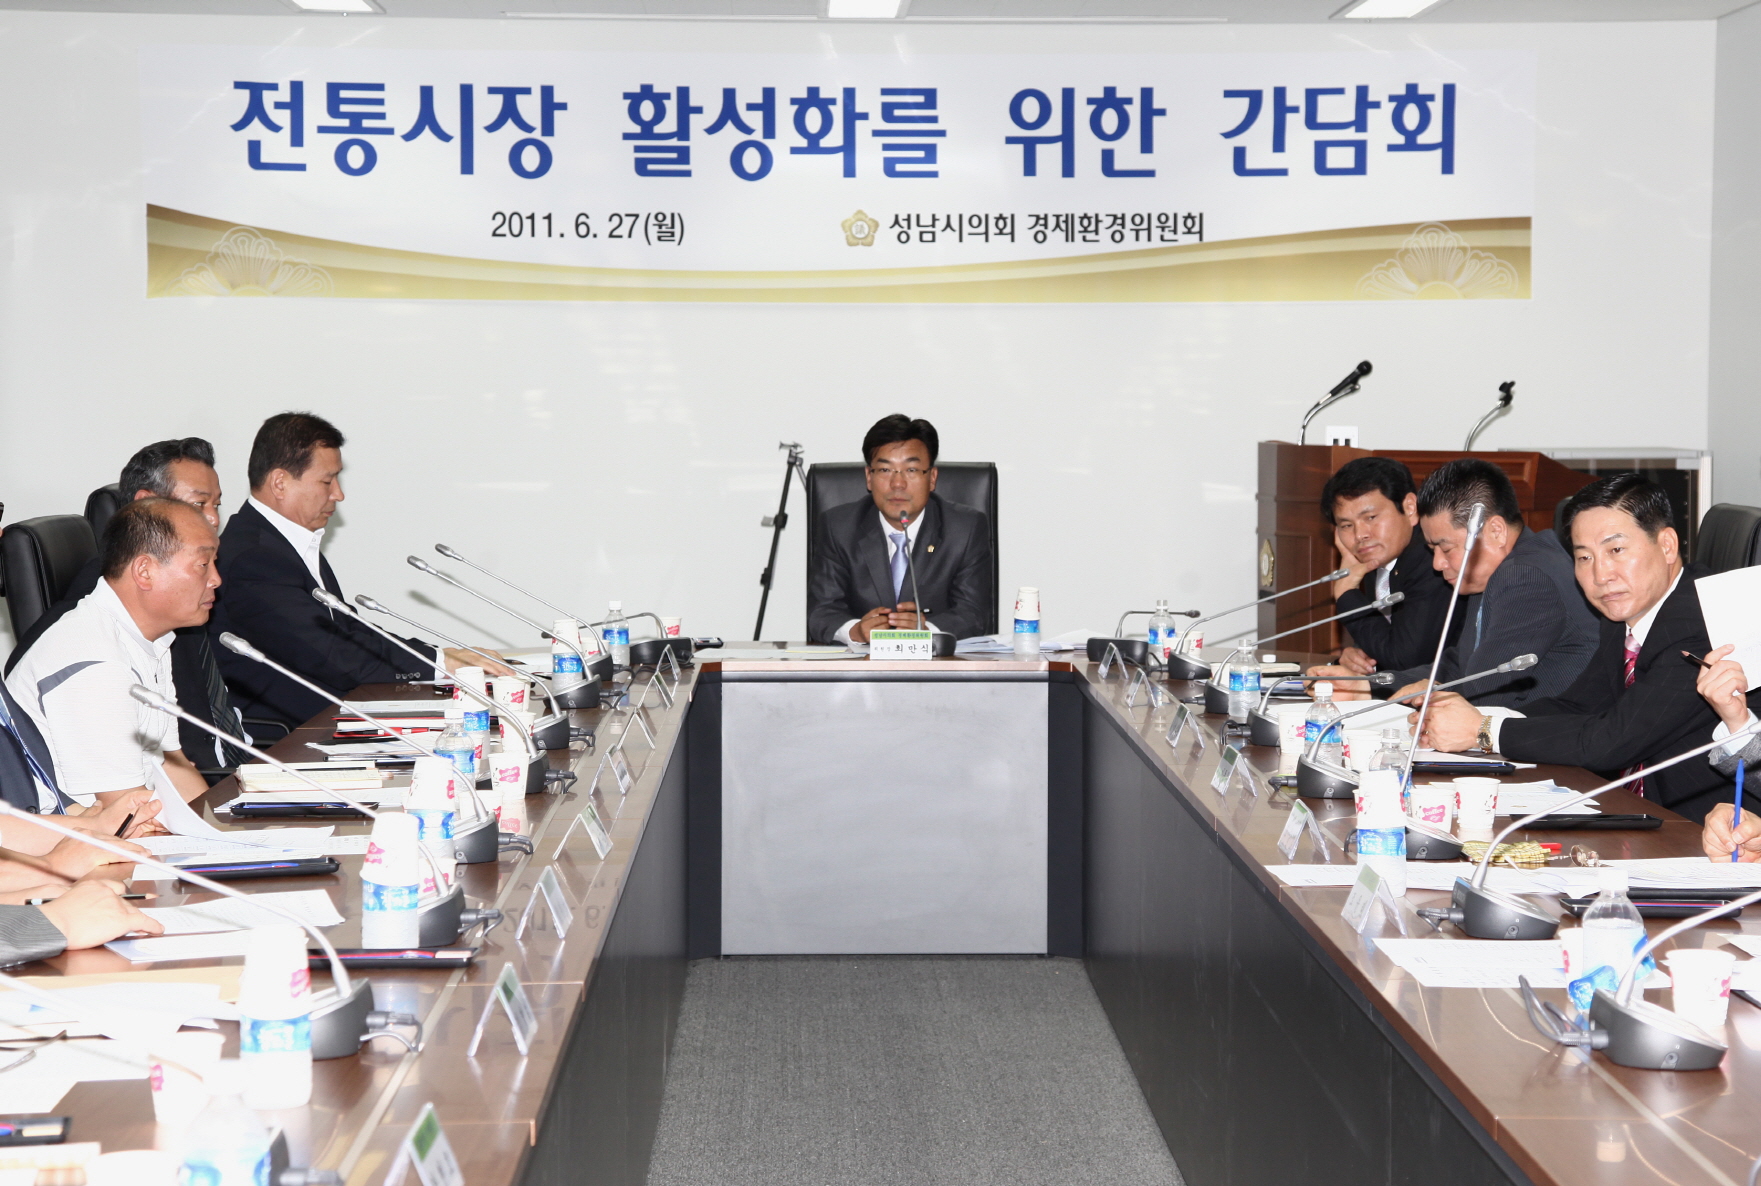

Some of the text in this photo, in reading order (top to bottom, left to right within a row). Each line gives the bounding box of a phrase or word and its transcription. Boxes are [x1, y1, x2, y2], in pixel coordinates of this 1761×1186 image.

[230, 80, 1456, 182] 전통시장 활성화를 위한 간담회
[491, 211, 685, 246] 2011. 6. 27(월)
[889, 213, 1015, 244] 성남시의회
[1028, 212, 1203, 244] 경제환경위원회
